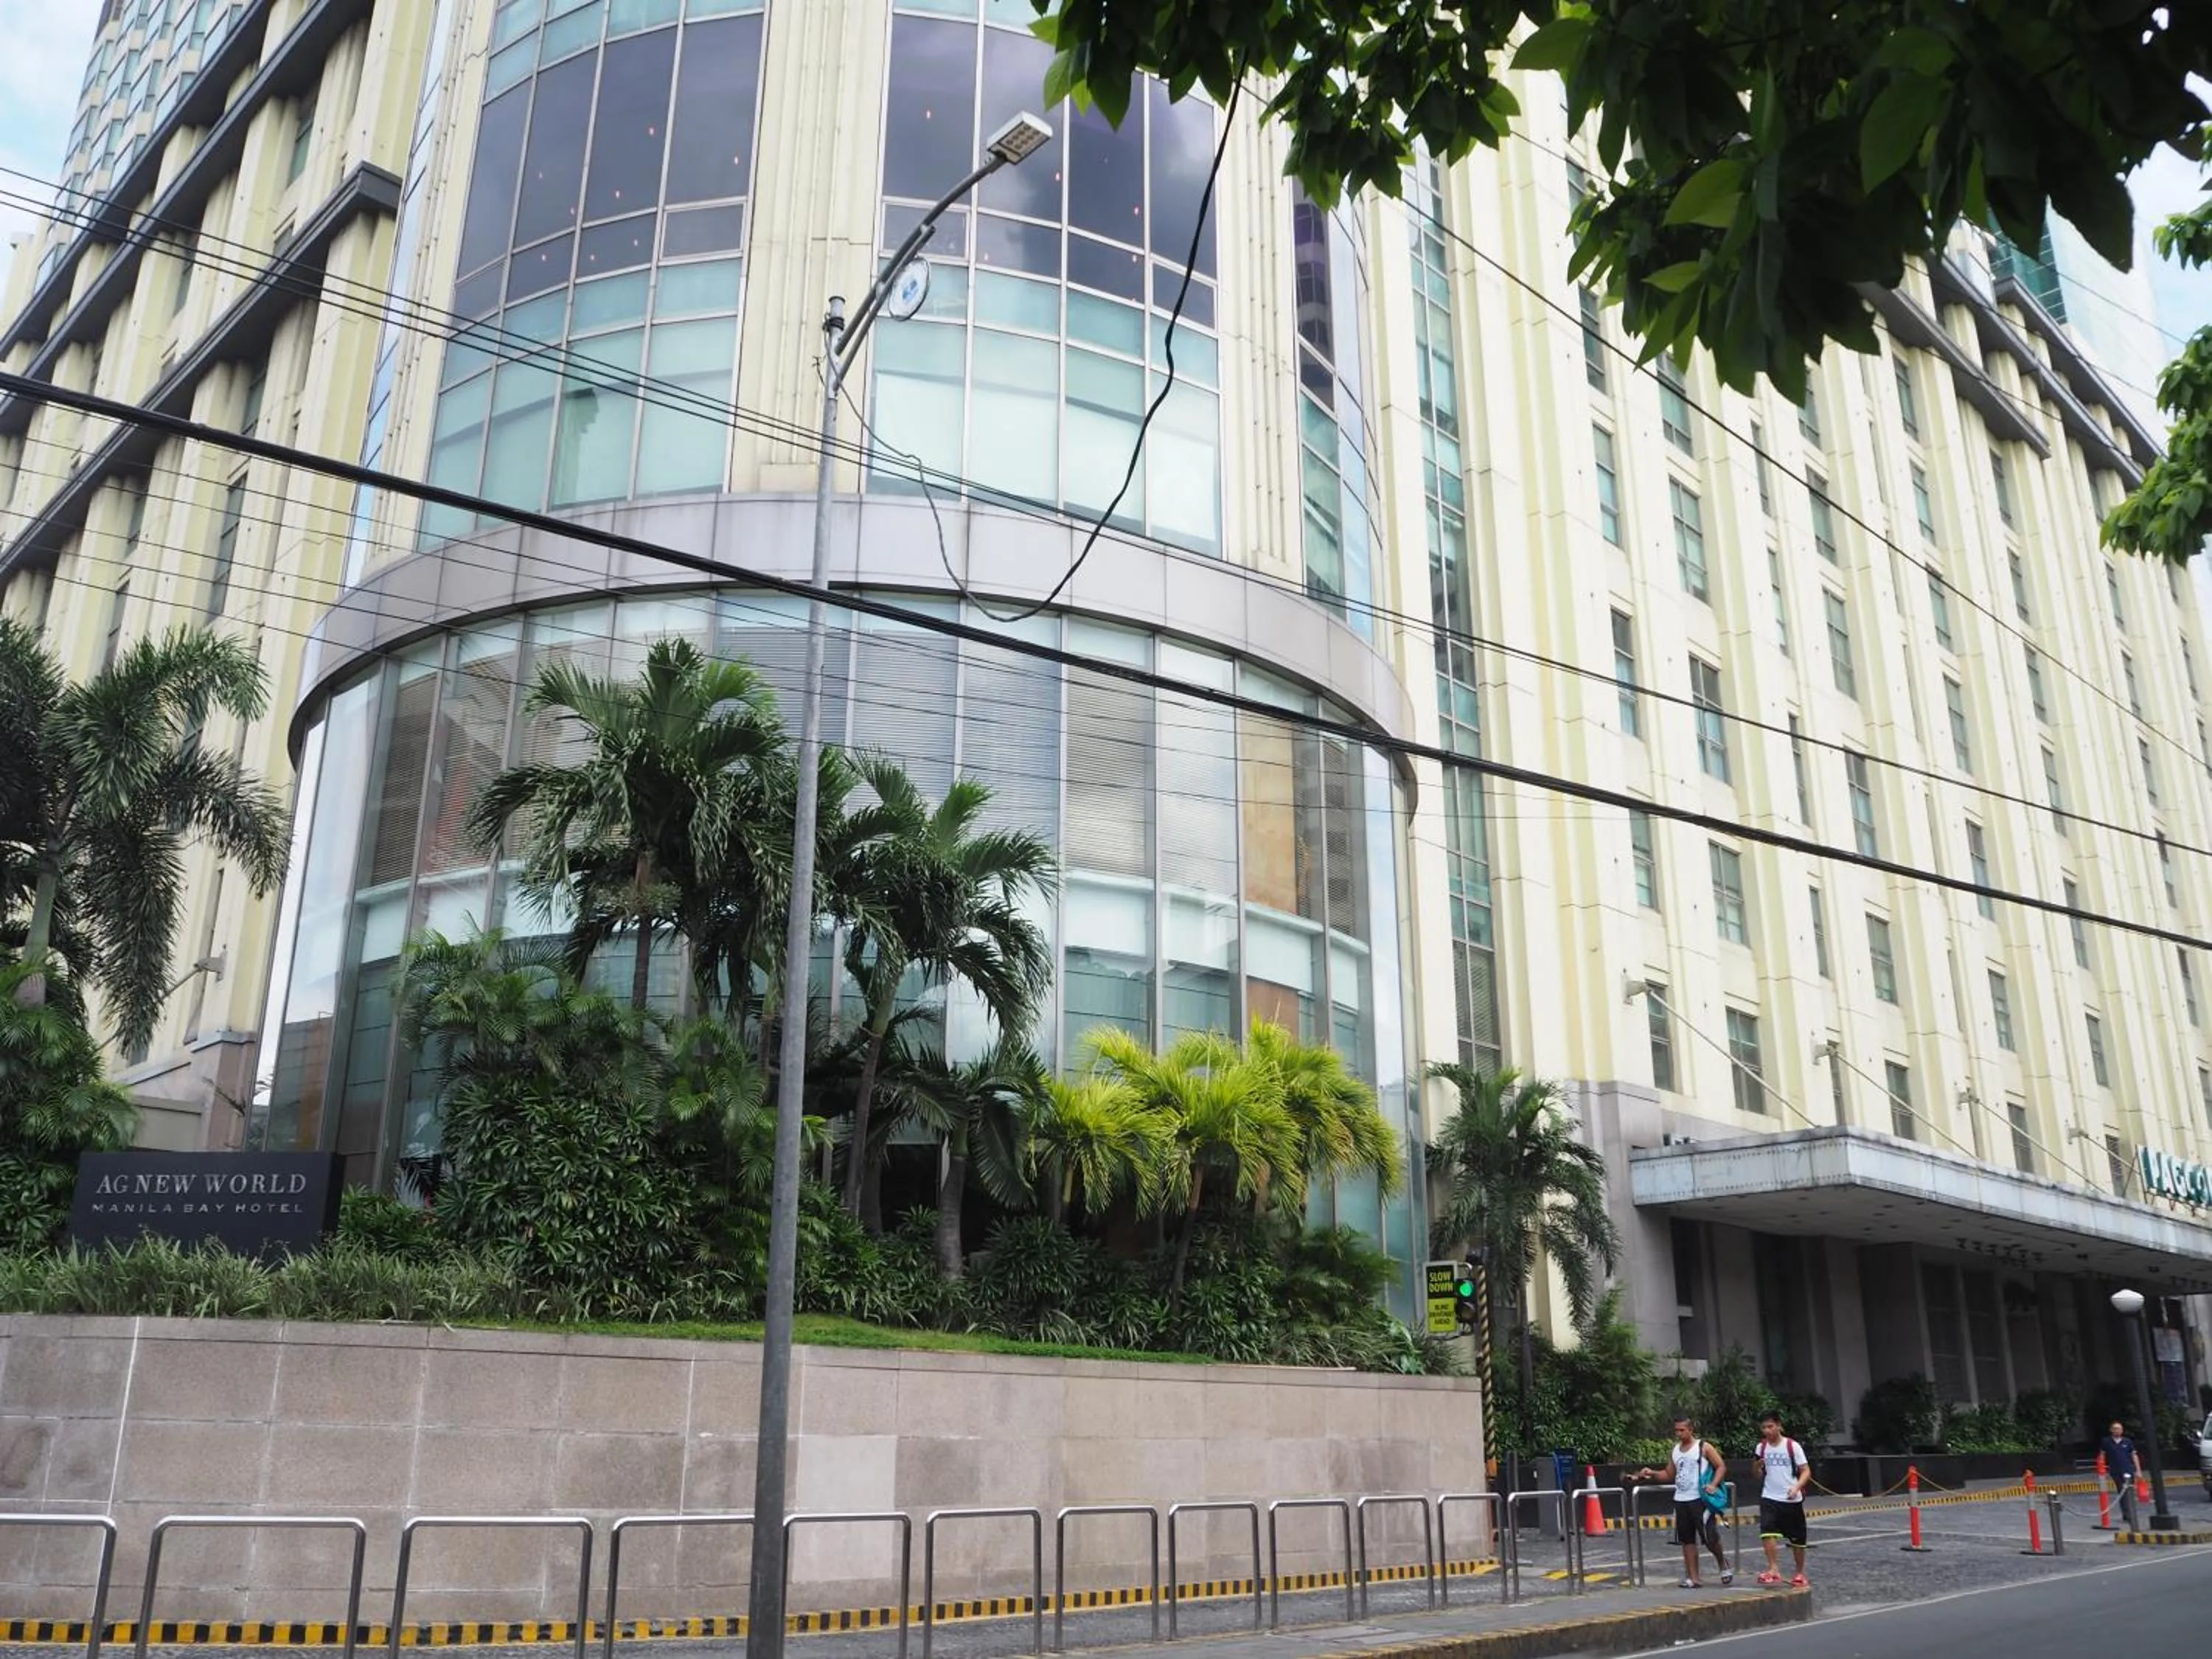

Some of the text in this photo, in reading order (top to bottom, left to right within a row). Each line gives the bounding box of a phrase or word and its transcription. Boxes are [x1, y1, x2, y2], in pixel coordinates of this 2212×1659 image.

[204, 1173, 307, 1194] WORLD
[92, 1203, 303, 1214] MANILA BAY HOTEL
[1429, 1271, 1451, 1282] SLOW
[1428, 1282, 1453, 1293] DOWN
